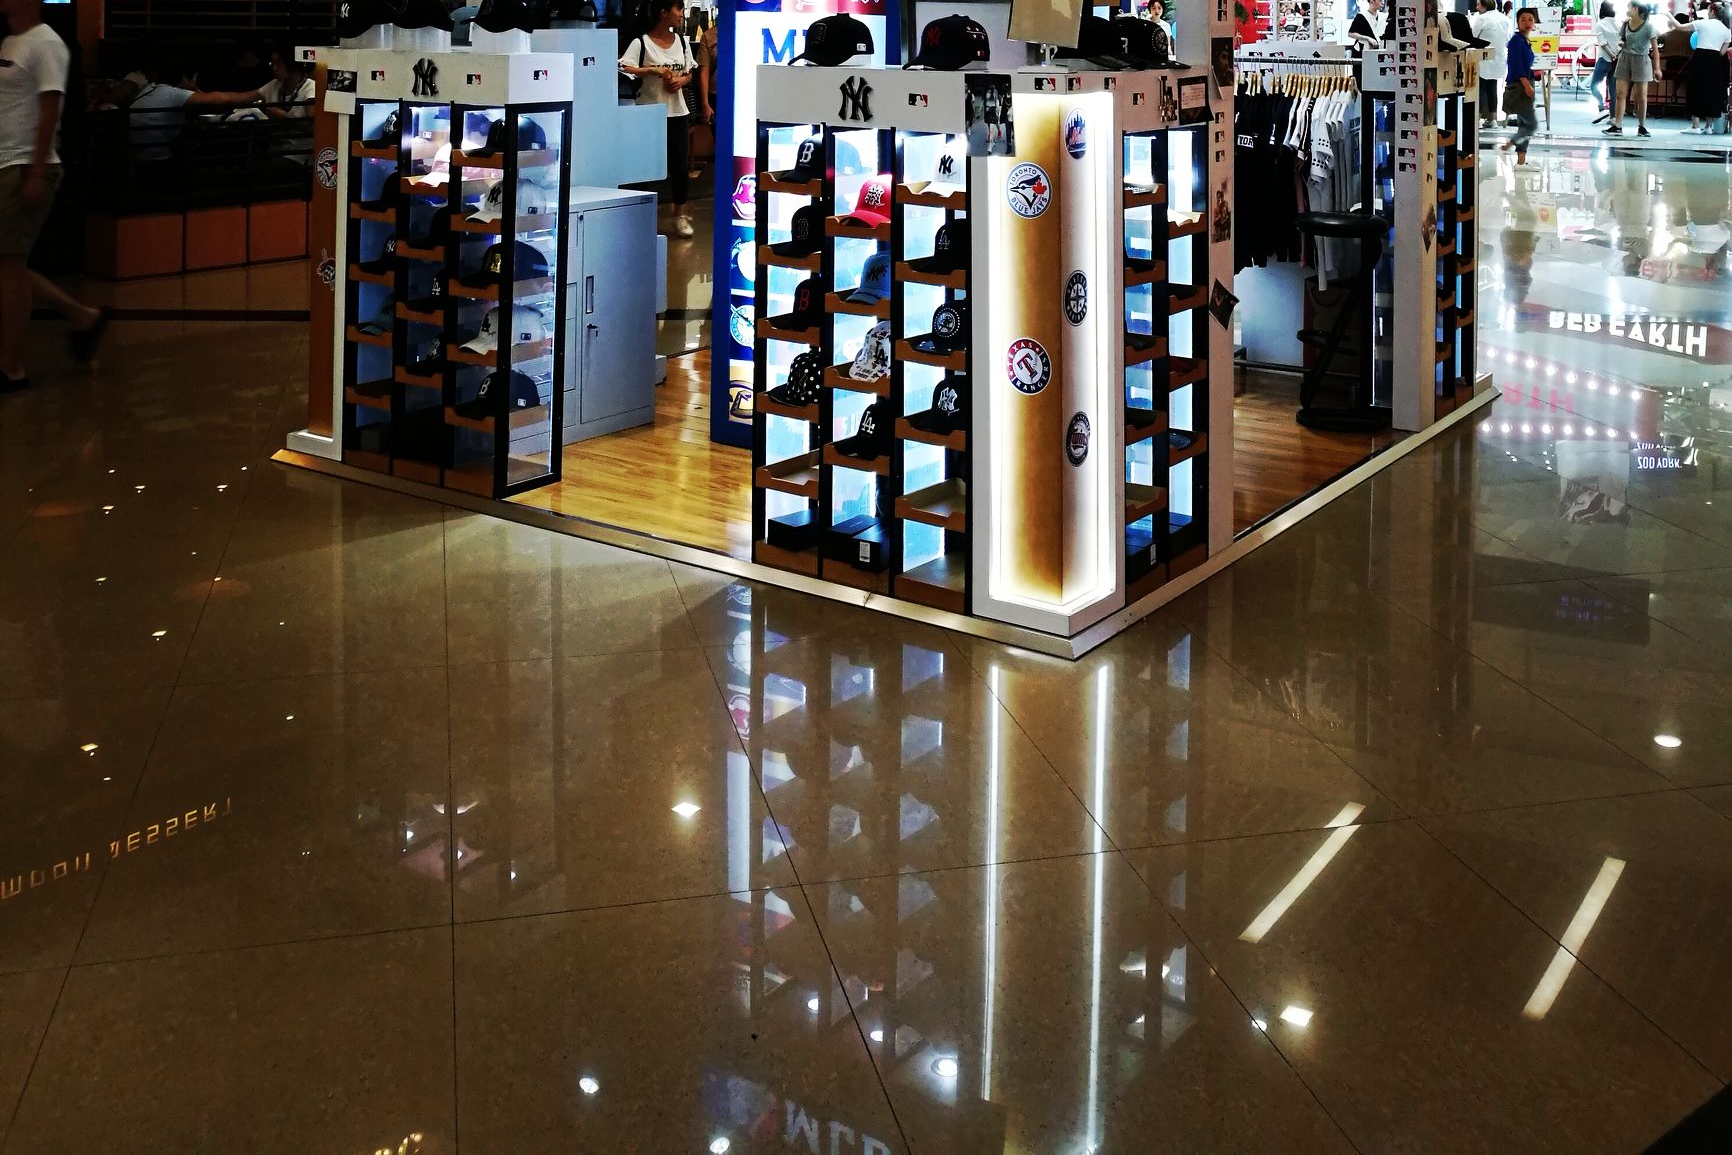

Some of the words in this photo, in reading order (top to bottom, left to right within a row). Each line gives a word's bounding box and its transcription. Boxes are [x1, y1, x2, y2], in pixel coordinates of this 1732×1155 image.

[411, 57, 440, 97] NY
[838, 75, 874, 122] NY
[1010, 167, 1037, 186] TORONTO
[1015, 357, 1050, 392] RANGERS
[861, 410, 876, 435] LA
